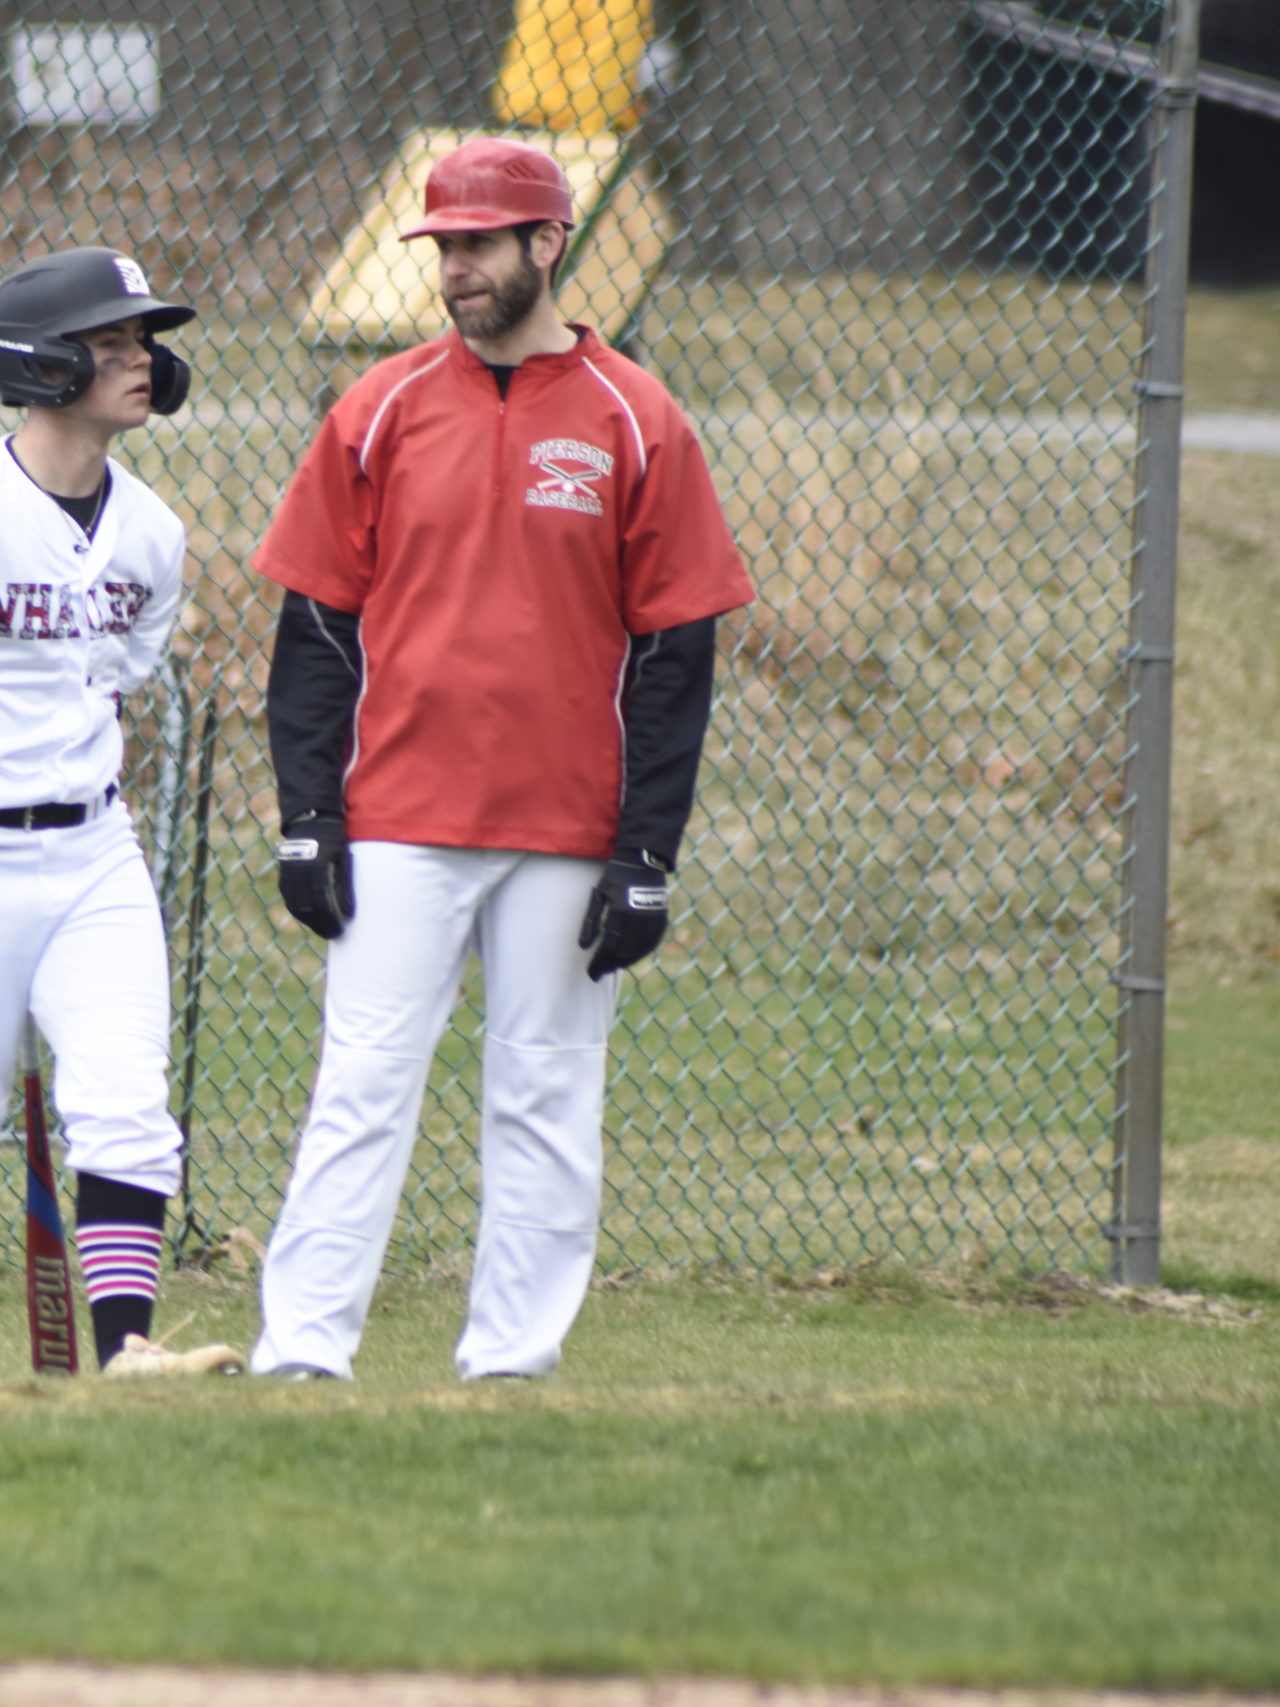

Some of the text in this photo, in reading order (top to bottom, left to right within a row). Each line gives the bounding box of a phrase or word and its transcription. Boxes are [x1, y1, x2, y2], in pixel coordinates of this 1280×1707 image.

[529, 438, 614, 477] PIERSON
[525, 488, 604, 517] BASEBALL
[35, 1256, 70, 1376] maru
